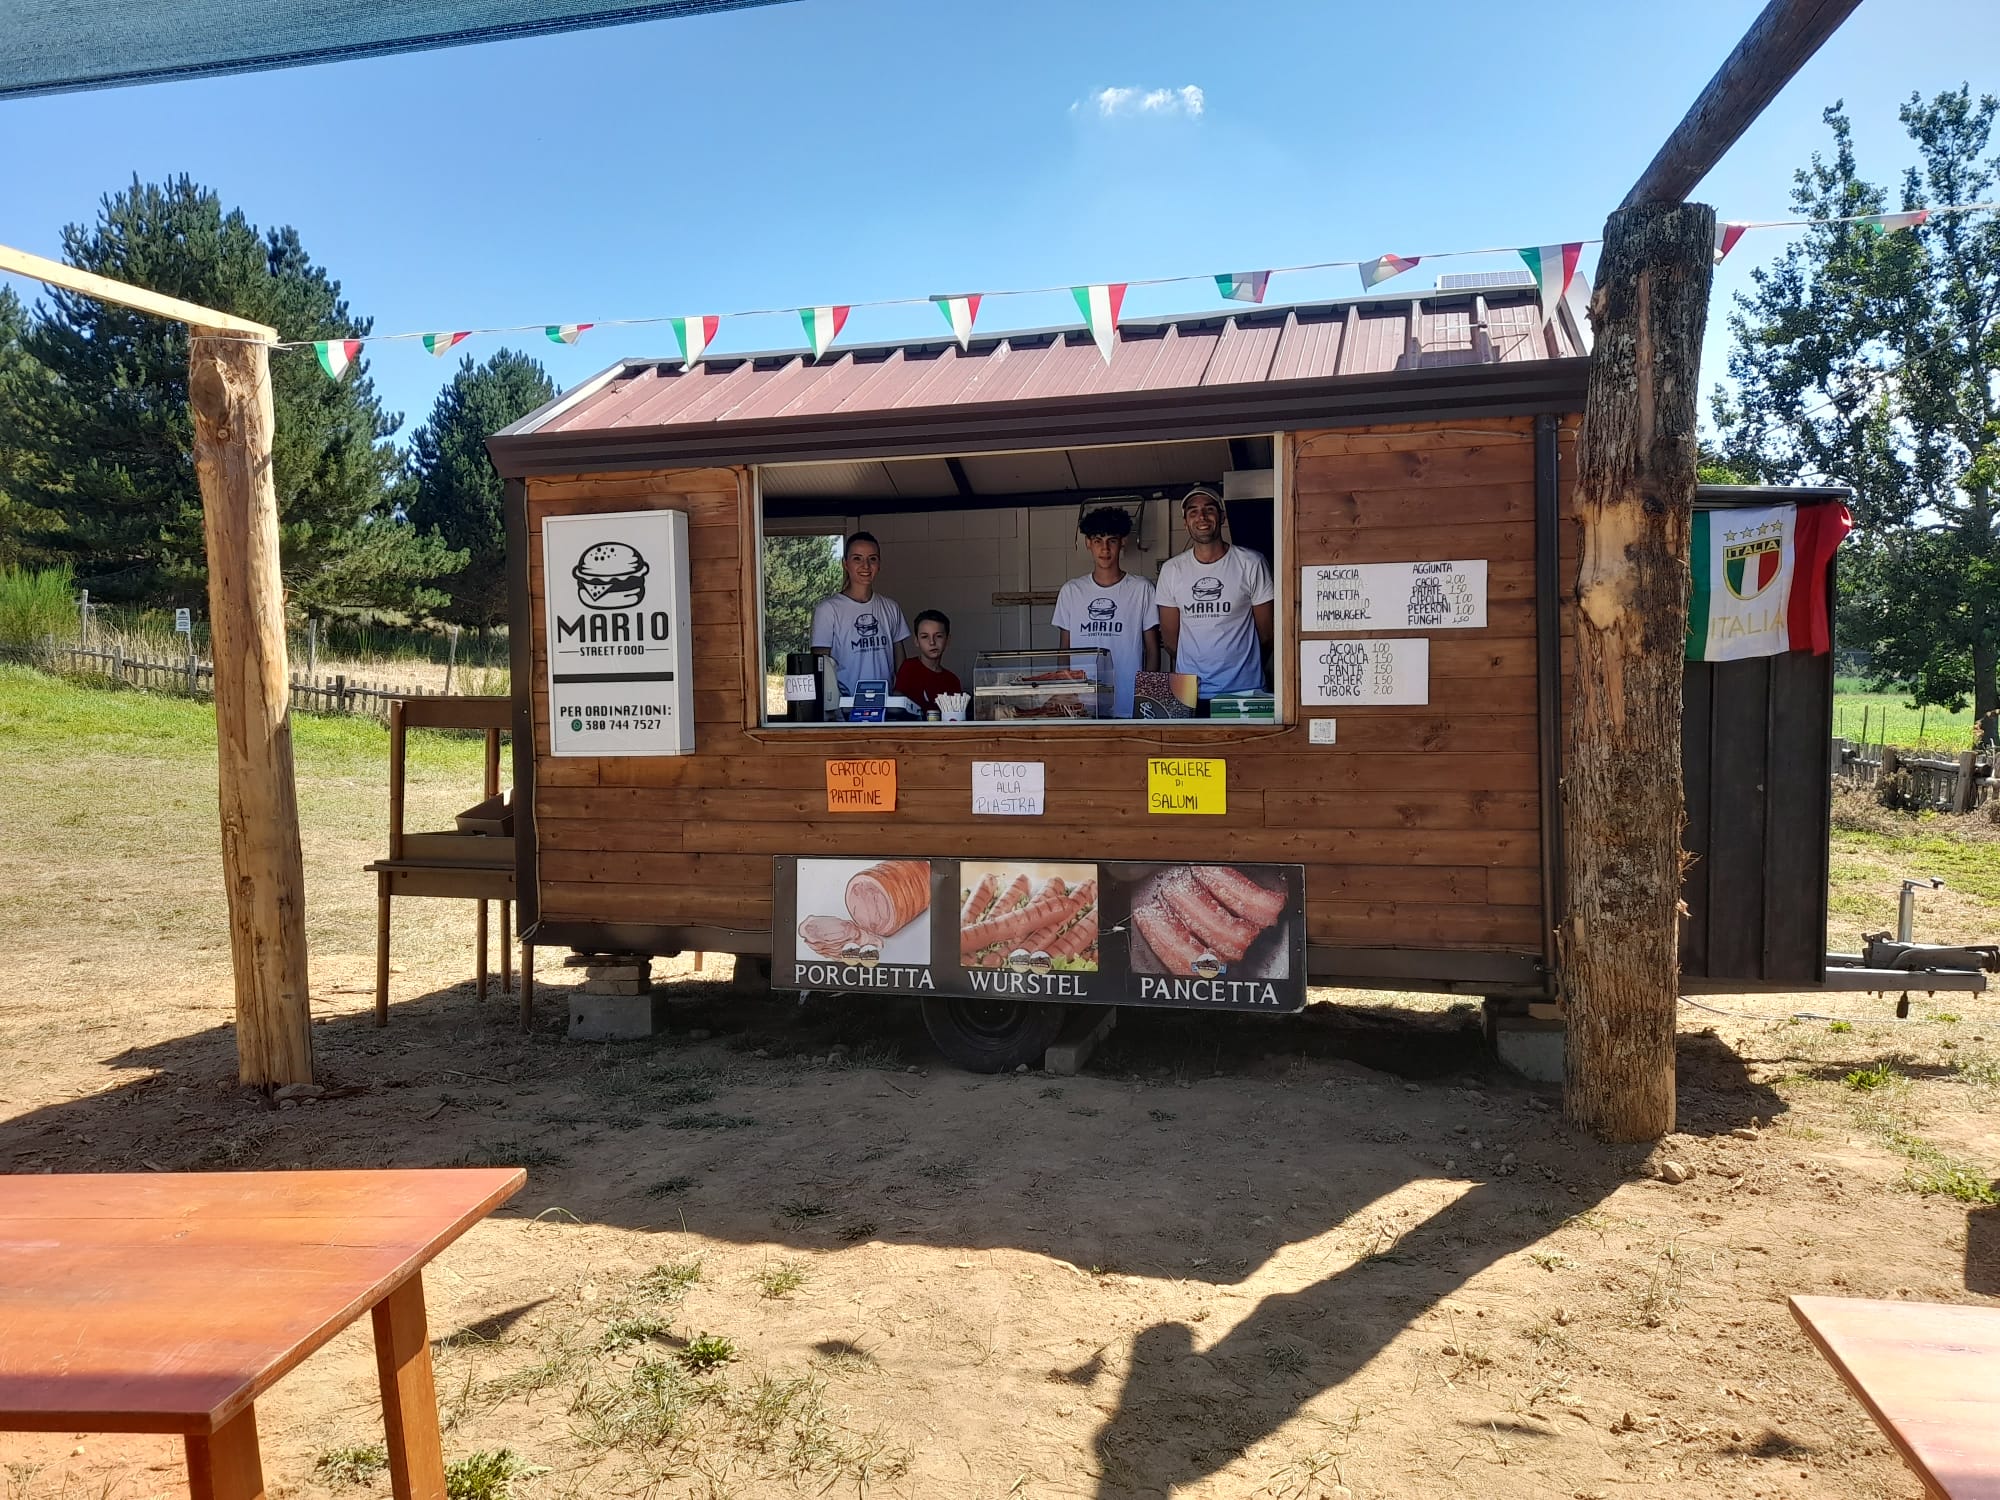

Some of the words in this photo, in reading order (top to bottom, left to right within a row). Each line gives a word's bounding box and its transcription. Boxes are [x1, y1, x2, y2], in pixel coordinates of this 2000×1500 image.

[1728, 540, 1778, 558] ITALIA
[1317, 568, 1359, 580] SALSICCIA
[1412, 562, 1453, 574] AGGIUNTA
[1415, 576, 1440, 587] CACIO
[1317, 589, 1360, 602] PANCETTA
[1412, 585, 1442, 597] PATATE
[1410, 594, 1447, 606] CIPOLLA
[1183, 601, 1231, 614] MARIO
[1317, 607, 1372, 621] HAMBURGER
[1407, 603, 1451, 614] PEPERONI
[1408, 614, 1442, 625] FUNGHI
[1711, 608, 1785, 640] ITALIA
[557, 611, 669, 643] MARIO
[1080, 621, 1123, 632] MARIO
[851, 636, 887, 650] MARIO
[1329, 643, 1364, 655] ACQUA
[580, 646, 615, 656] STREET
[618, 645, 645, 656] FOOD
[1328, 664, 1363, 676] FANTA
[1323, 675, 1363, 685] DREHER
[1317, 685, 1361, 696] TUBORG
[560, 705, 582, 717] PER
[585, 704, 672, 717] ORDINAZIONI:
[585, 720, 606, 730] 380
[609, 719, 629, 730] 744
[633, 719, 661, 730] 7527
[830, 760, 891, 776] CARTOCCIO
[980, 763, 1027, 778] CACIO
[1150, 761, 1212, 777] TAGLIERE
[853, 776, 864, 788] DI
[996, 781, 1021, 793] ALLA
[829, 789, 882, 805] PATATINE
[1152, 793, 1198, 810] SALUMI
[976, 797, 1036, 813] PIASTRA
[794, 964, 936, 990] PORCHETTA
[967, 968, 1088, 996] WÜRSTEL
[1140, 977, 1280, 1005] PANCETTA
